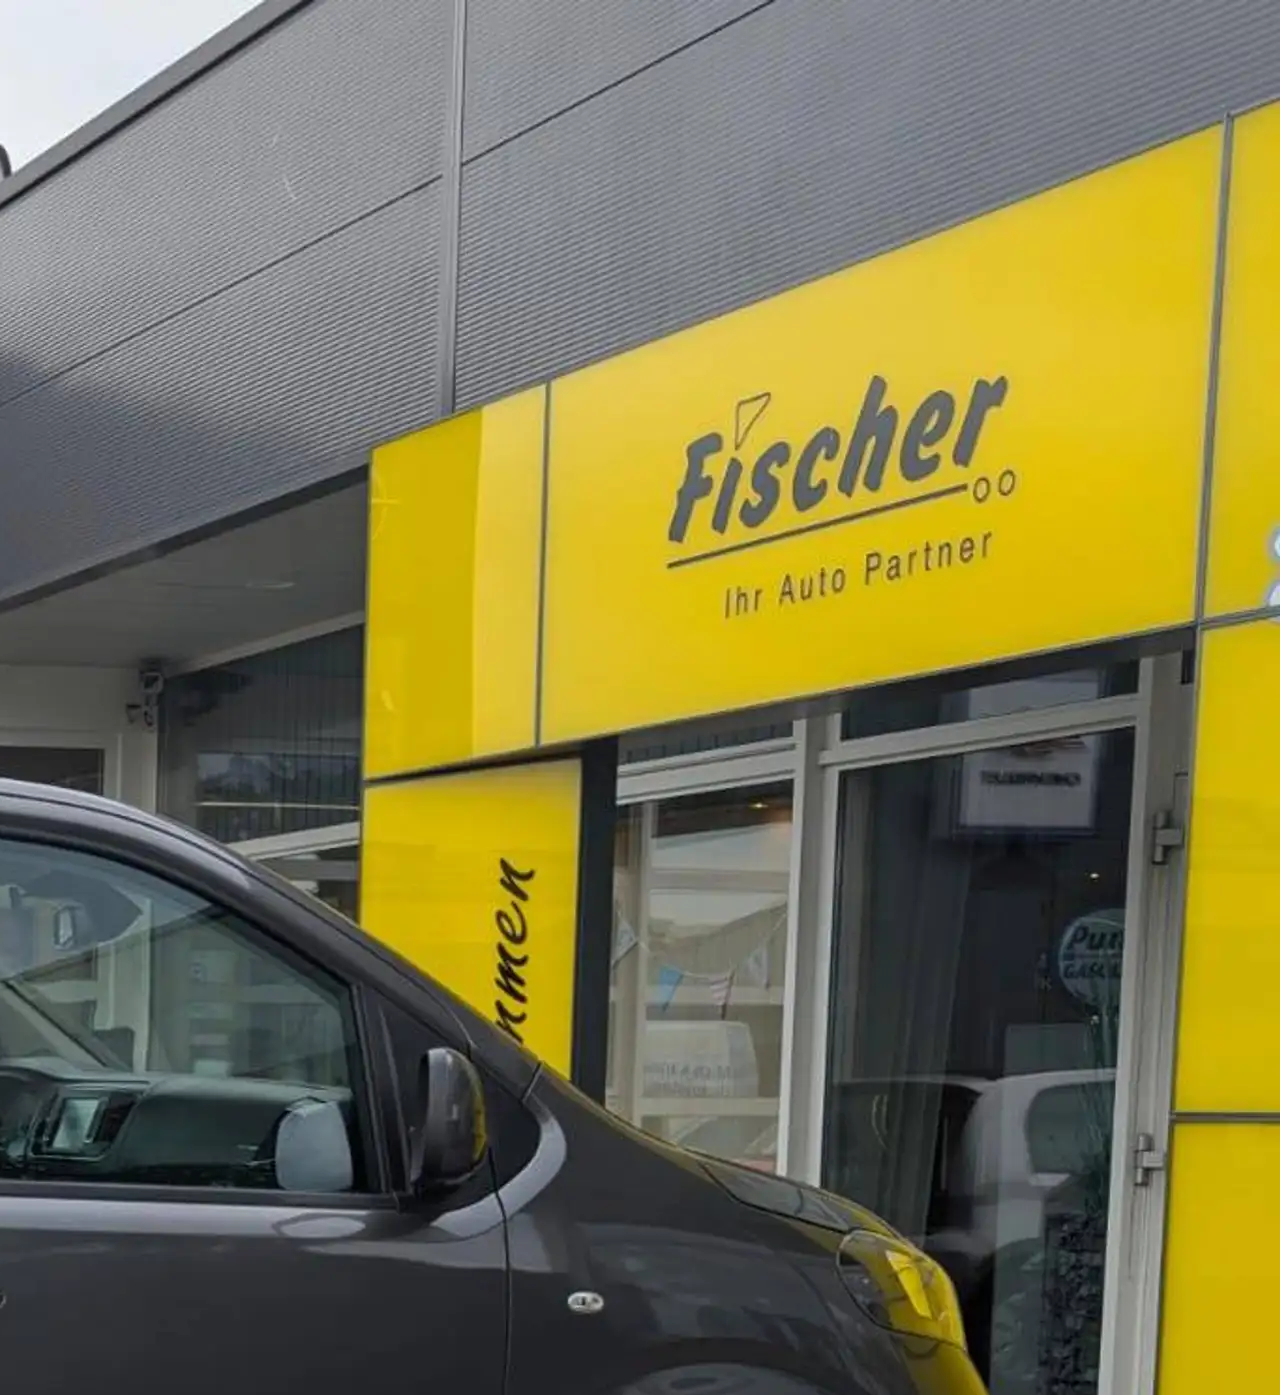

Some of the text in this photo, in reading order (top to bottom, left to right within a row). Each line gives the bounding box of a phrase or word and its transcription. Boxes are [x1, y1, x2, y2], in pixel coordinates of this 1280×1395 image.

[667, 374, 1009, 543] Fischer
[724, 531, 993, 619] Ihr Auto Partner
